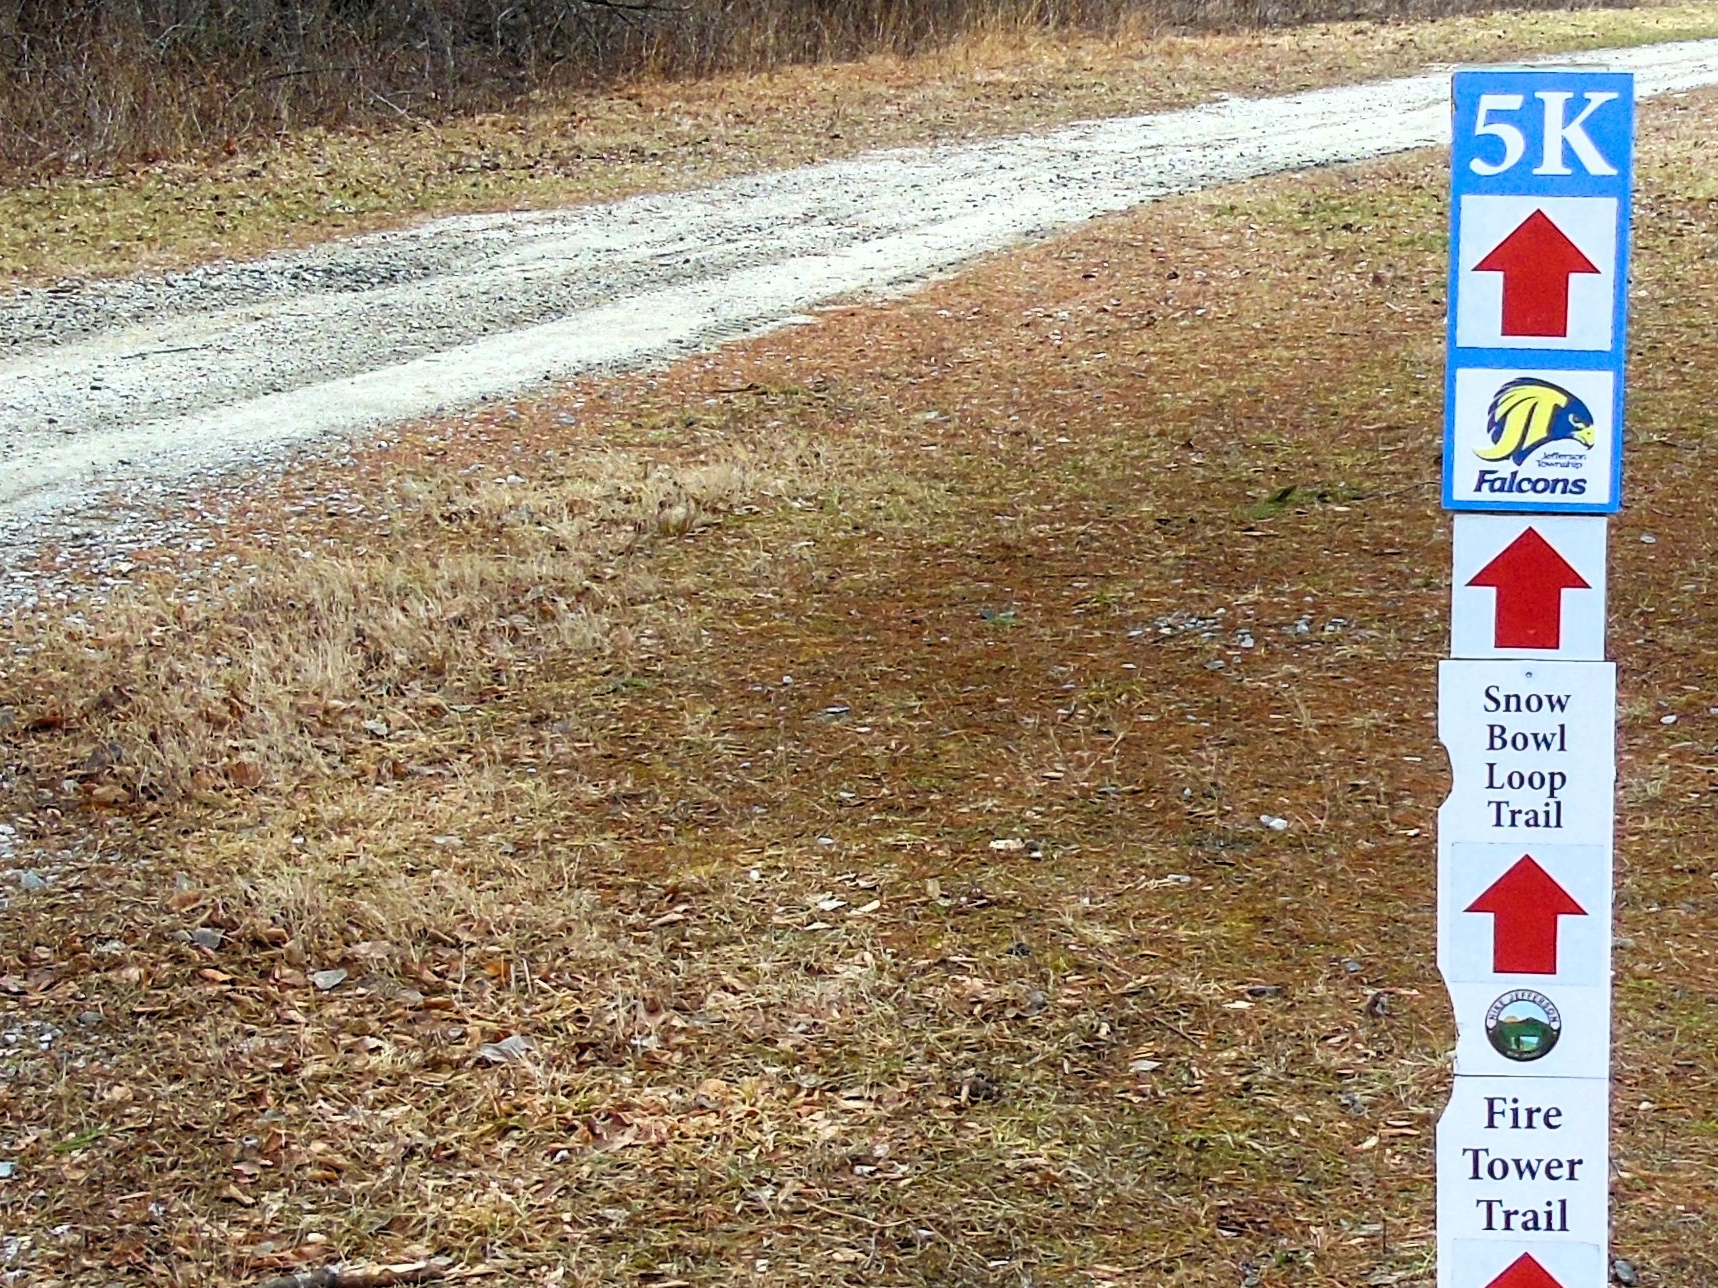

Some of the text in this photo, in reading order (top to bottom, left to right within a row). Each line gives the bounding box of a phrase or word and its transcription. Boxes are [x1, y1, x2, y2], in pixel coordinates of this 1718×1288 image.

[1469, 91, 1619, 177] 5K
[1536, 460, 1583, 469] Township
[1542, 452, 1586, 460] Jefferson
[1473, 470, 1587, 495] Falcons
[1484, 685, 1571, 713] Snow
[1486, 724, 1567, 752] Bowl
[1485, 763, 1567, 798] Loop
[1488, 801, 1563, 828] Trail
[1509, 991, 1558, 1023] JEFFERSON
[1484, 1097, 1563, 1130] Fire
[1462, 1148, 1584, 1181] Tower
[1476, 1199, 1570, 1232] Trail
